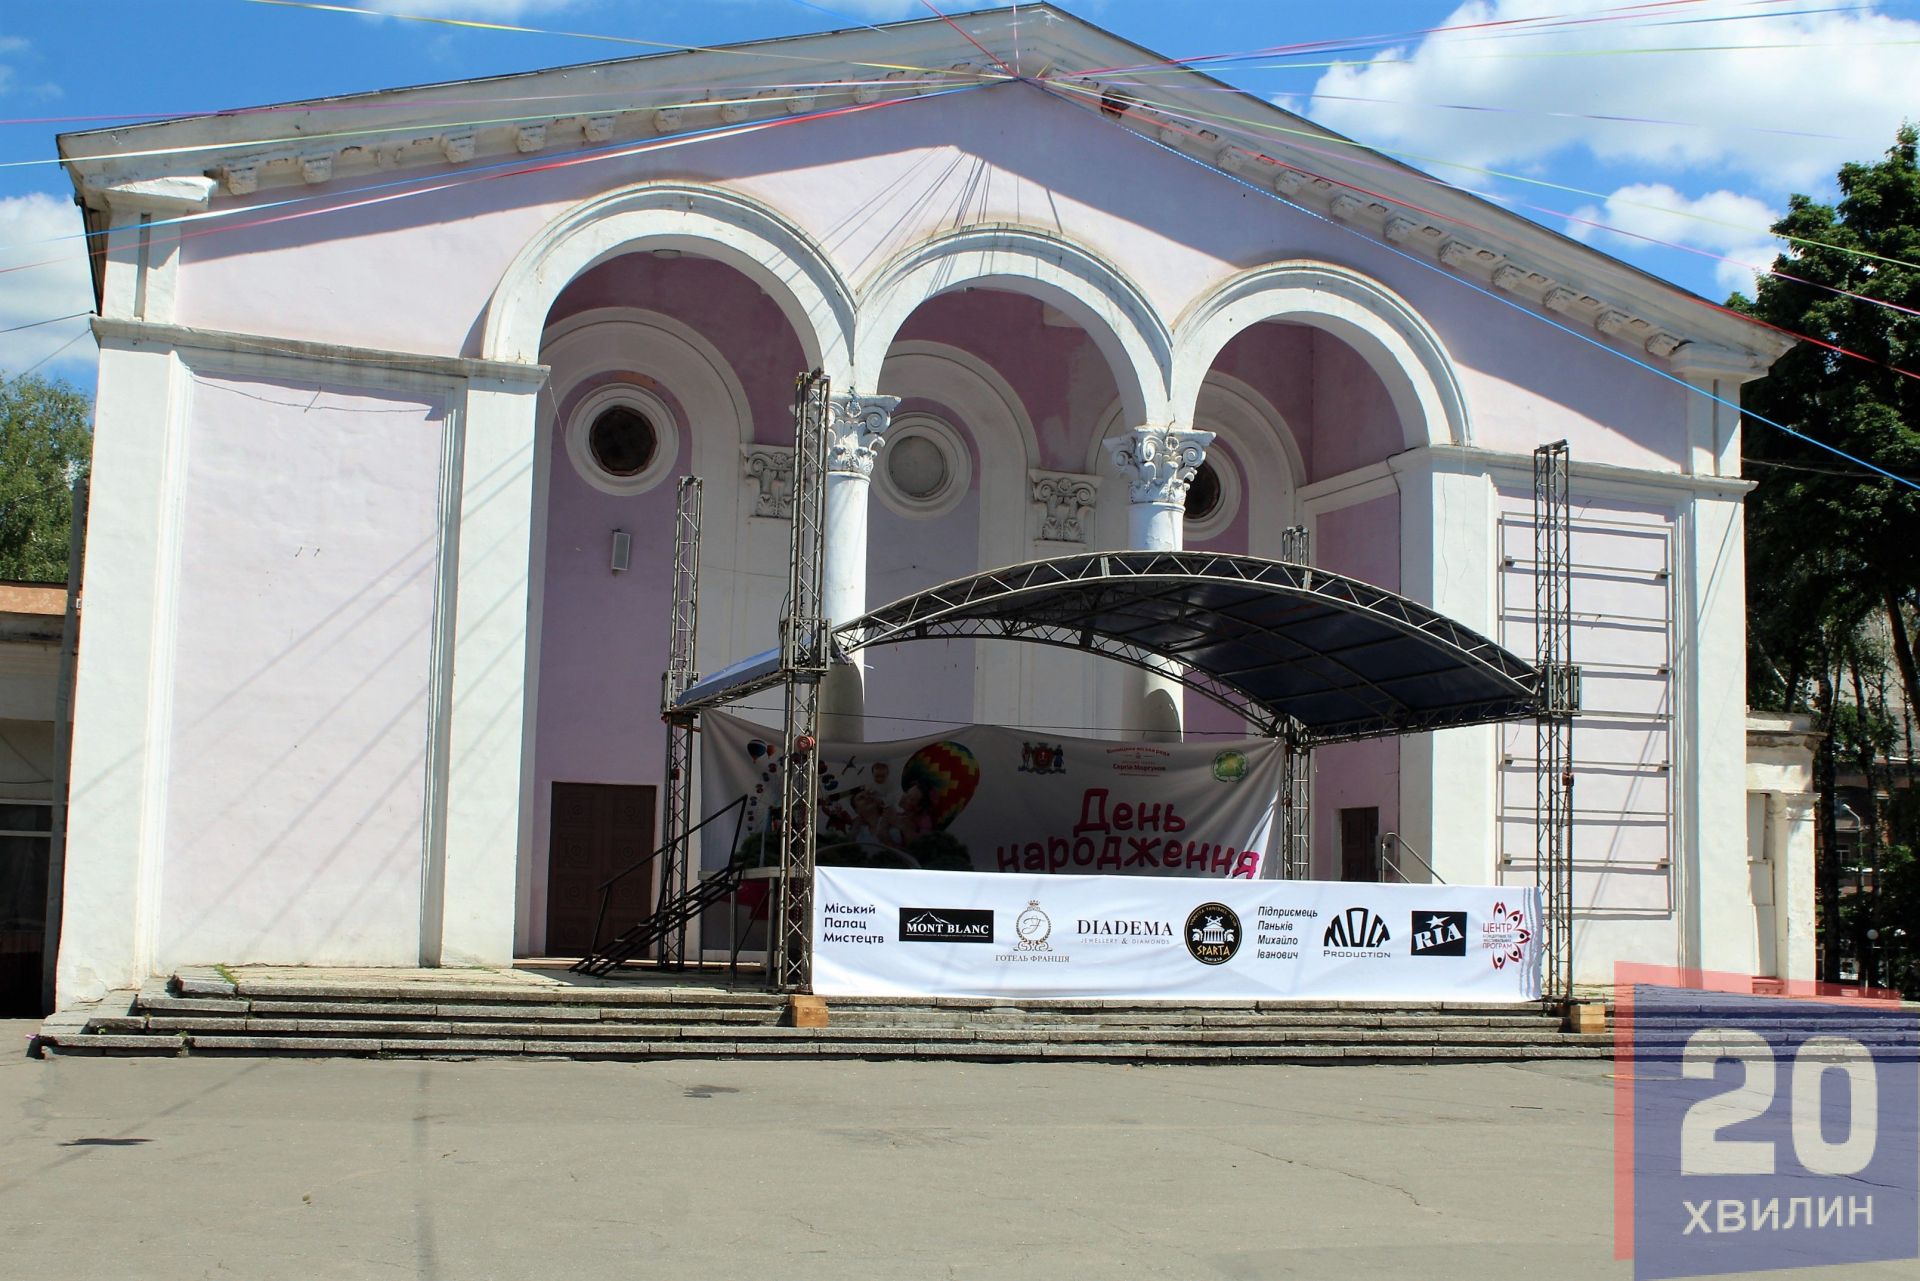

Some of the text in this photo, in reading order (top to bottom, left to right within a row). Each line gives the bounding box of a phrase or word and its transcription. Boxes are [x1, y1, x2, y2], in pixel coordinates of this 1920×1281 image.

[1073, 788, 1186, 837] День
[997, 836, 1259, 879] народження
[824, 903, 876, 914] Міський
[1257, 906, 1318, 919] Підприємець
[824, 917, 867, 930] Палац
[906, 923, 989, 934] MONT BLANC
[1077, 919, 1174, 936] DIADEMA
[1257, 920, 1293, 931] Паньків
[1482, 922, 1513, 934] ЦЕНТР
[823, 932, 884, 944] Мистецтв
[1257, 934, 1299, 945] Михайло
[1414, 922, 1464, 951] RIA
[1197, 945, 1231, 956] SPARTA
[1257, 948, 1299, 960] Іванович
[995, 954, 1070, 963] ГОТЕЛЬ ФРАНЦІЯ
